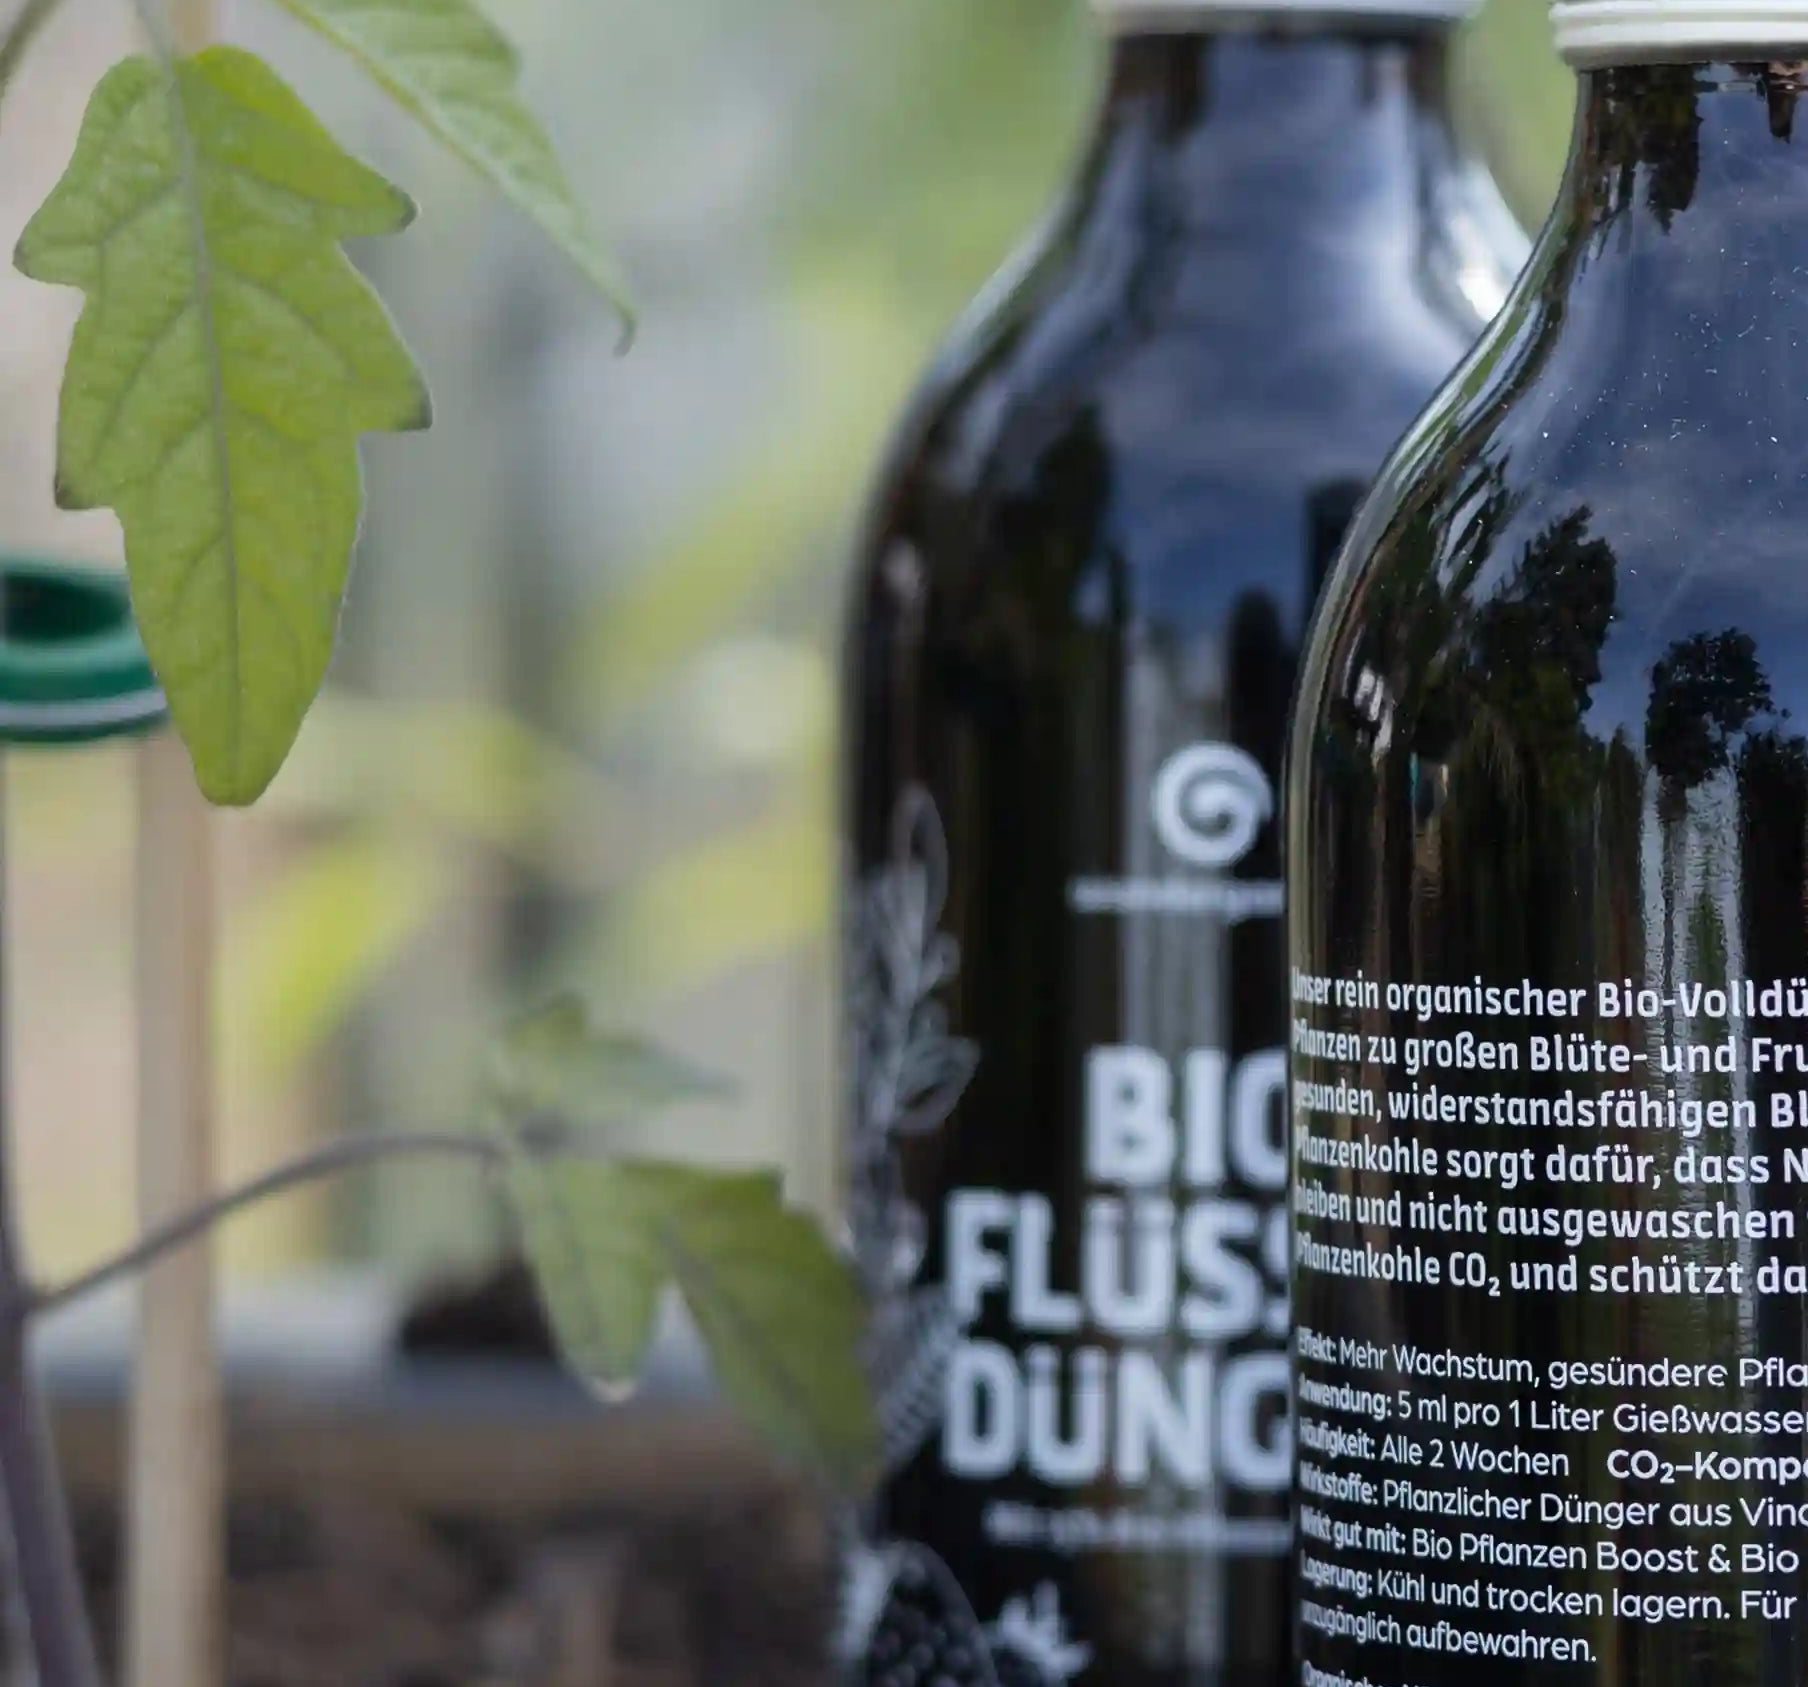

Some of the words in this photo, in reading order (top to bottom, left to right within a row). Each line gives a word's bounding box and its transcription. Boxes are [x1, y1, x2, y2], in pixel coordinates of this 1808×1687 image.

[1292, 966, 1331, 1004] Unser
[1336, 969, 1379, 1009] rein
[1387, 975, 1587, 1021] organischer
[1293, 1017, 1361, 1061] Pflanzen
[1367, 1035, 1397, 1064] zu
[1405, 1031, 1518, 1075] großen
[1530, 1034, 1648, 1072] Blüte-
[1660, 1036, 1737, 1073] und
[1086, 1045, 1287, 1188] BIO
[1388, 1082, 1755, 1137] widerstandsfähigen
[1295, 1124, 1438, 1176] Pflanzenkohle
[1447, 1147, 1534, 1188] sorgt
[1546, 1144, 1661, 1189] dafür,
[1674, 1146, 1770, 1183] dass
[1355, 1190, 1402, 1228] und
[1410, 1192, 1487, 1233] nicht
[1498, 1202, 1794, 1246] ausgewaschen
[943, 1188, 1289, 1338] FLÜS
[1296, 1230, 1440, 1285] Pflanzenkohle
[1510, 1255, 1577, 1292] und
[1590, 1254, 1743, 1294] schützt
[1340, 1337, 1387, 1371] Mehr
[1393, 1343, 1540, 1388] Wachstum,
[1548, 1356, 1728, 1390] gesündere
[944, 1340, 1290, 1488] DÜNG
[1299, 1372, 1392, 1422] Anwendung:
[1398, 1390, 1412, 1419] 5
[1418, 1394, 1447, 1426] ml
[1454, 1399, 1500, 1430] pro
[1509, 1398, 1521, 1428] 1
[1531, 1400, 1604, 1432] Liter
[1380, 1433, 1423, 1466] Alle
[1429, 1438, 1445, 1468] 2
[1451, 1441, 1569, 1477] Wochen
[1383, 1479, 1531, 1521] Pflanzlicher
[1540, 1492, 1660, 1531] Dünger
[1670, 1501, 1732, 1528] aus
[1334, 1519, 1362, 1550] gut
[1366, 1522, 1406, 1556] mit:
[1412, 1530, 1452, 1560] Bio
[1460, 1532, 1586, 1570] Pflanzen
[1597, 1541, 1699, 1573] Boost
[1708, 1542, 1731, 1574] &
[1741, 1541, 1799, 1574] Bio
[1378, 1568, 1425, 1602] Kühl
[1431, 1579, 1479, 1610] und
[1487, 1583, 1603, 1617] trocken
[1612, 1588, 1730, 1624] lagern.
[1741, 1589, 1797, 1621] Für
[1406, 1623, 1597, 1663] aufbewahren.
